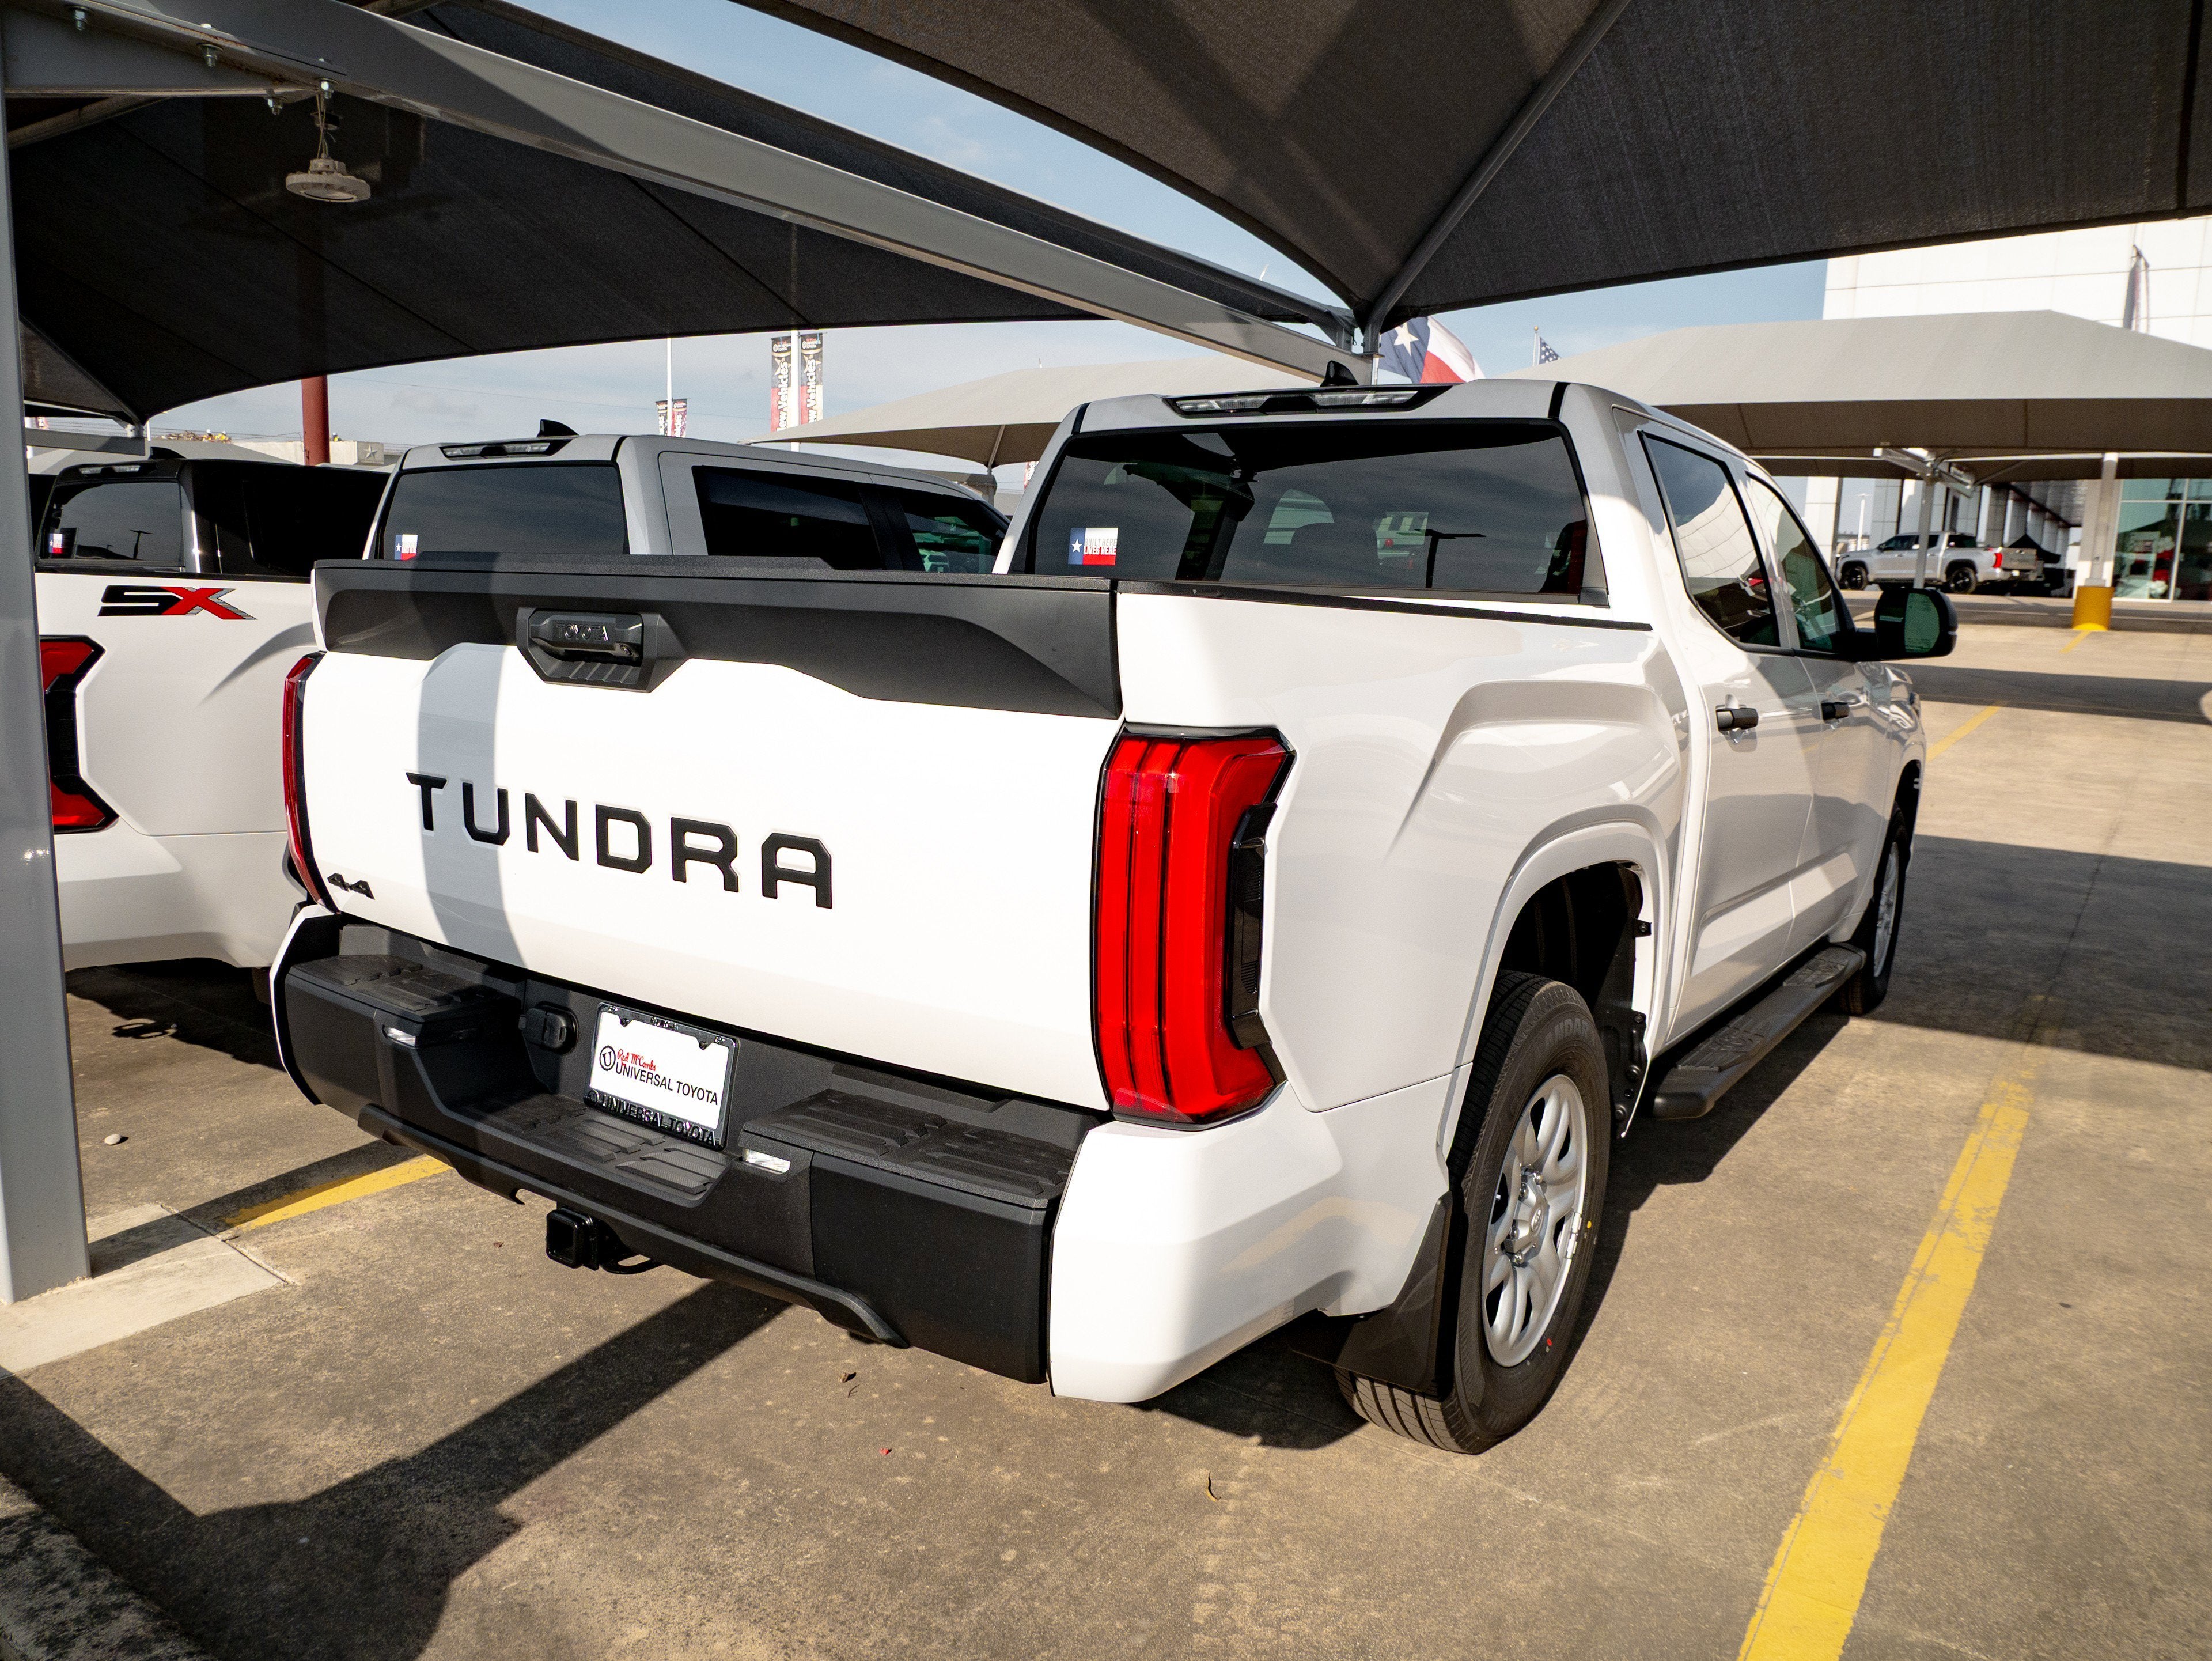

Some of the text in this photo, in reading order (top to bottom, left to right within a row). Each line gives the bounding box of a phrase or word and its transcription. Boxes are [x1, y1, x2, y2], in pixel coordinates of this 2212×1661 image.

[778, 361, 788, 410] Vehicles
[806, 358, 816, 408] Vehicles
[777, 411, 787, 432] ew
[1084, 546, 1116, 555] LIVES HERE
[1085, 538, 1117, 546] BUILT HERE
[556, 623, 609, 641] TOYOTA
[406, 772, 832, 909] TUNDRA
[617, 1049, 656, 1072] Red McCombs
[616, 1062, 718, 1106] UNIVERSAL TOYOTA
[599, 1094, 668, 1127] UNIVERSAL
[668, 1117, 716, 1146] TOYOTA
